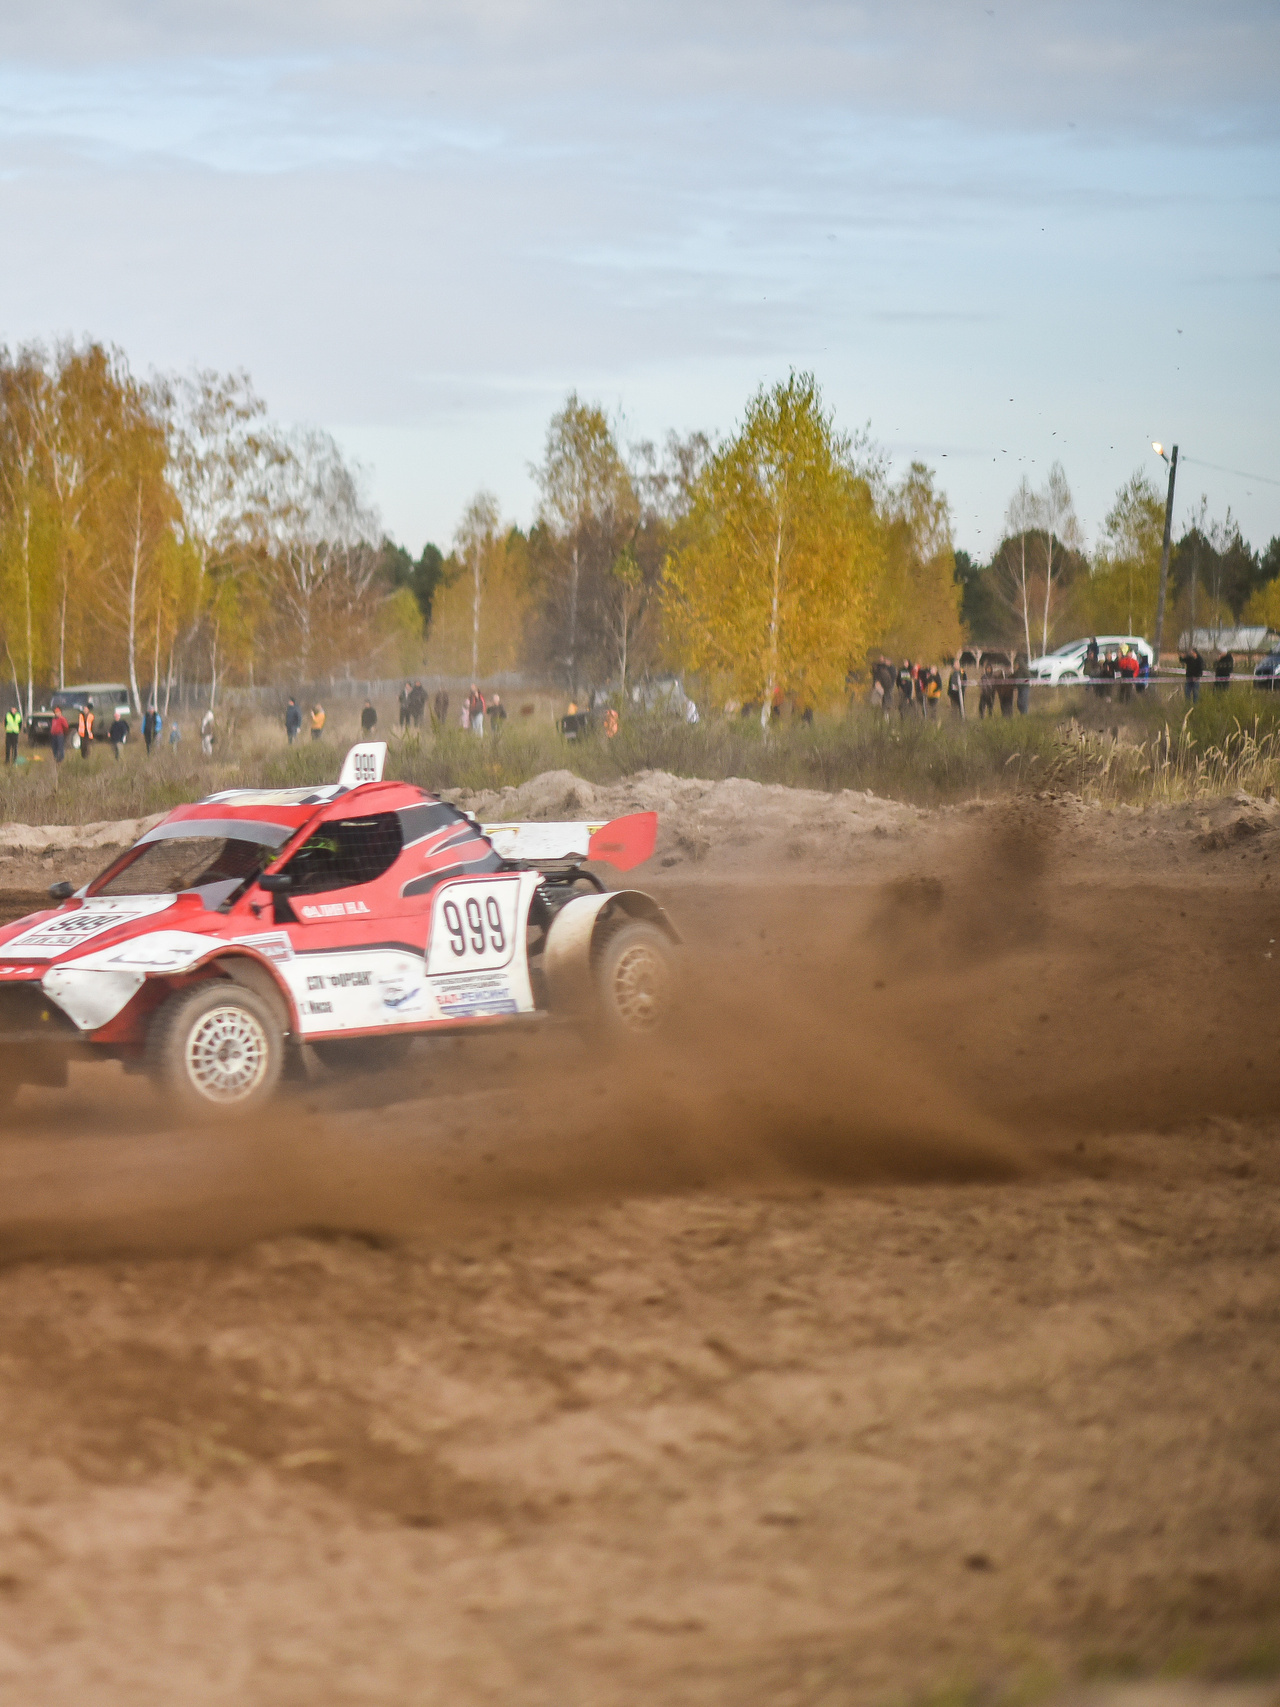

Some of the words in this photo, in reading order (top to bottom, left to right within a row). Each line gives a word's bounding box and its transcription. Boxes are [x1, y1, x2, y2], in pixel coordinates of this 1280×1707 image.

[355, 753, 376, 781] 999
[48, 915, 123, 932] 999
[443, 896, 506, 957] 999
